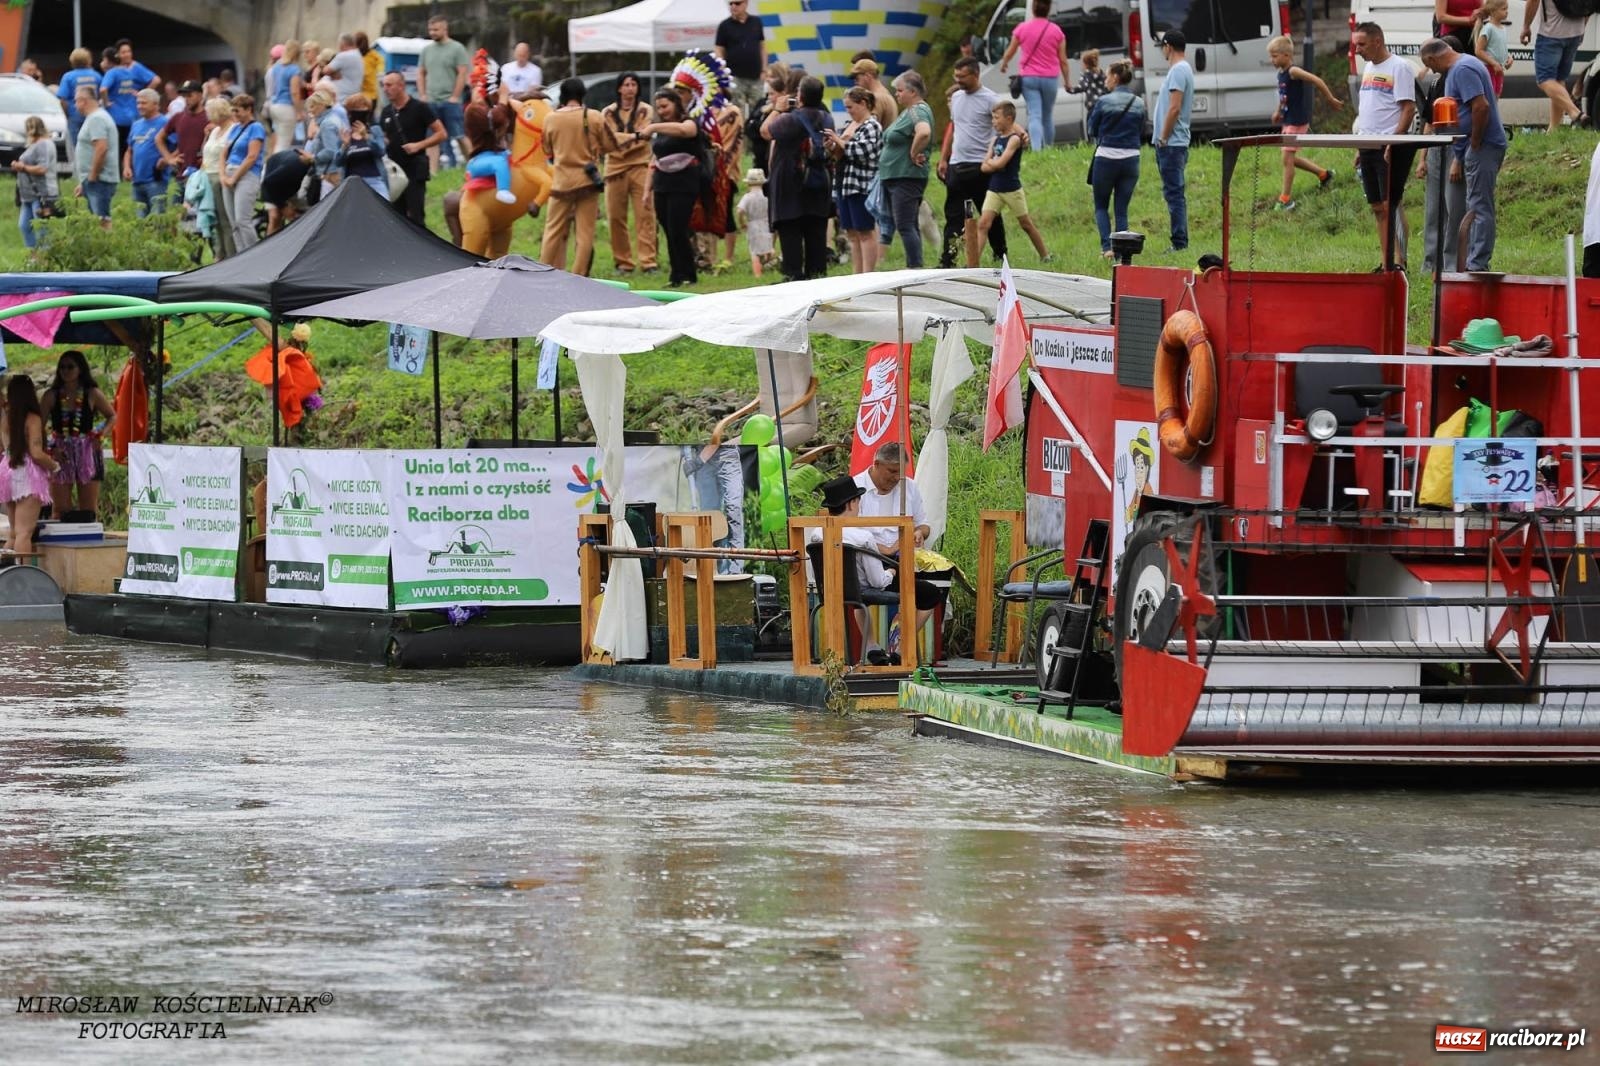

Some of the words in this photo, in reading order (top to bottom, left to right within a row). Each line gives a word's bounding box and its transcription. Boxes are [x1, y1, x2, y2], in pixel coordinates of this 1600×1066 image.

[1034, 338, 1044, 356] Do
[1066, 341, 1069, 358] i
[1071, 341, 1099, 364] jeszcze
[1044, 439, 1070, 472] BIZON
[404, 458, 444, 475] Unia
[449, 457, 472, 474] lat
[476, 457, 499, 474] 20
[504, 460, 547, 473] ma...
[185, 476, 206, 488] MYCIE
[208, 476, 232, 489] KOSTKI
[331, 480, 354, 493] MYCIE
[356, 480, 382, 494] KOSTKI
[406, 482, 410, 496] I
[415, 485, 424, 496] z
[428, 480, 468, 496] nami
[472, 484, 484, 494] o
[487, 479, 552, 498] czystość
[1503, 470, 1533, 492] 22
[186, 496, 206, 510] MYCIE
[333, 502, 354, 515] MYCIE
[407, 506, 494, 522] Raciborza
[497, 504, 530, 520] dba
[186, 518, 206, 531] MYCIE
[208, 516, 236, 532] DACHÓW
[334, 524, 354, 537] MYCIE
[356, 522, 389, 538] DACHÓW
[450, 558, 494, 568] PROFADA
[412, 584, 520, 598] WWW.PROFADA.PL
